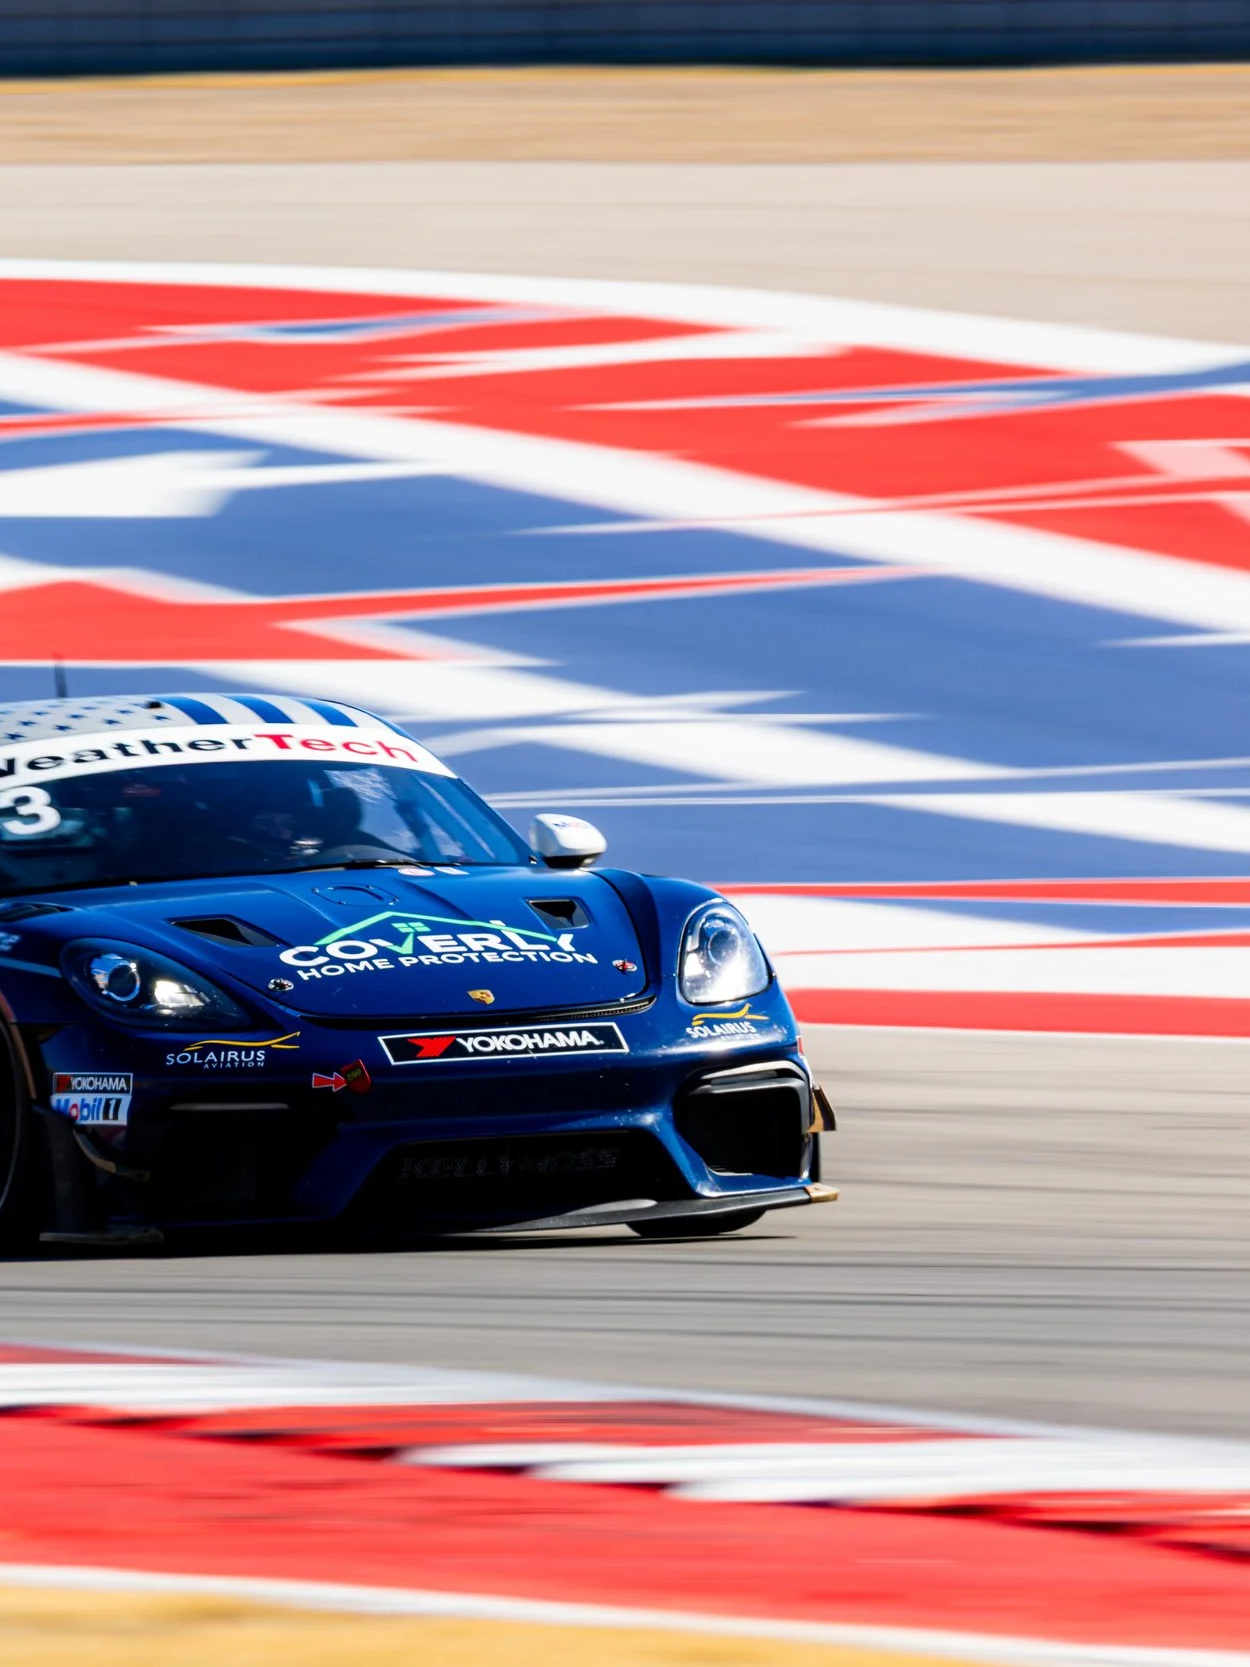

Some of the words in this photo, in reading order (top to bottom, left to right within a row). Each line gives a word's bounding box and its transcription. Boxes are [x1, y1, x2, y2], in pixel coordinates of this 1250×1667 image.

[279, 920, 575, 967] COVERLY
[297, 957, 395, 981] HOME
[398, 950, 598, 968] PROTECTION
[685, 1020, 757, 1039] SOLAIRUS
[457, 1029, 602, 1053] YOKOHAMA
[165, 1050, 266, 1066] SOLAIRUS
[203, 1060, 265, 1069] AVIATION
[71, 1076, 128, 1091] YOKOHAMA
[53, 1097, 103, 1121] Mobil
